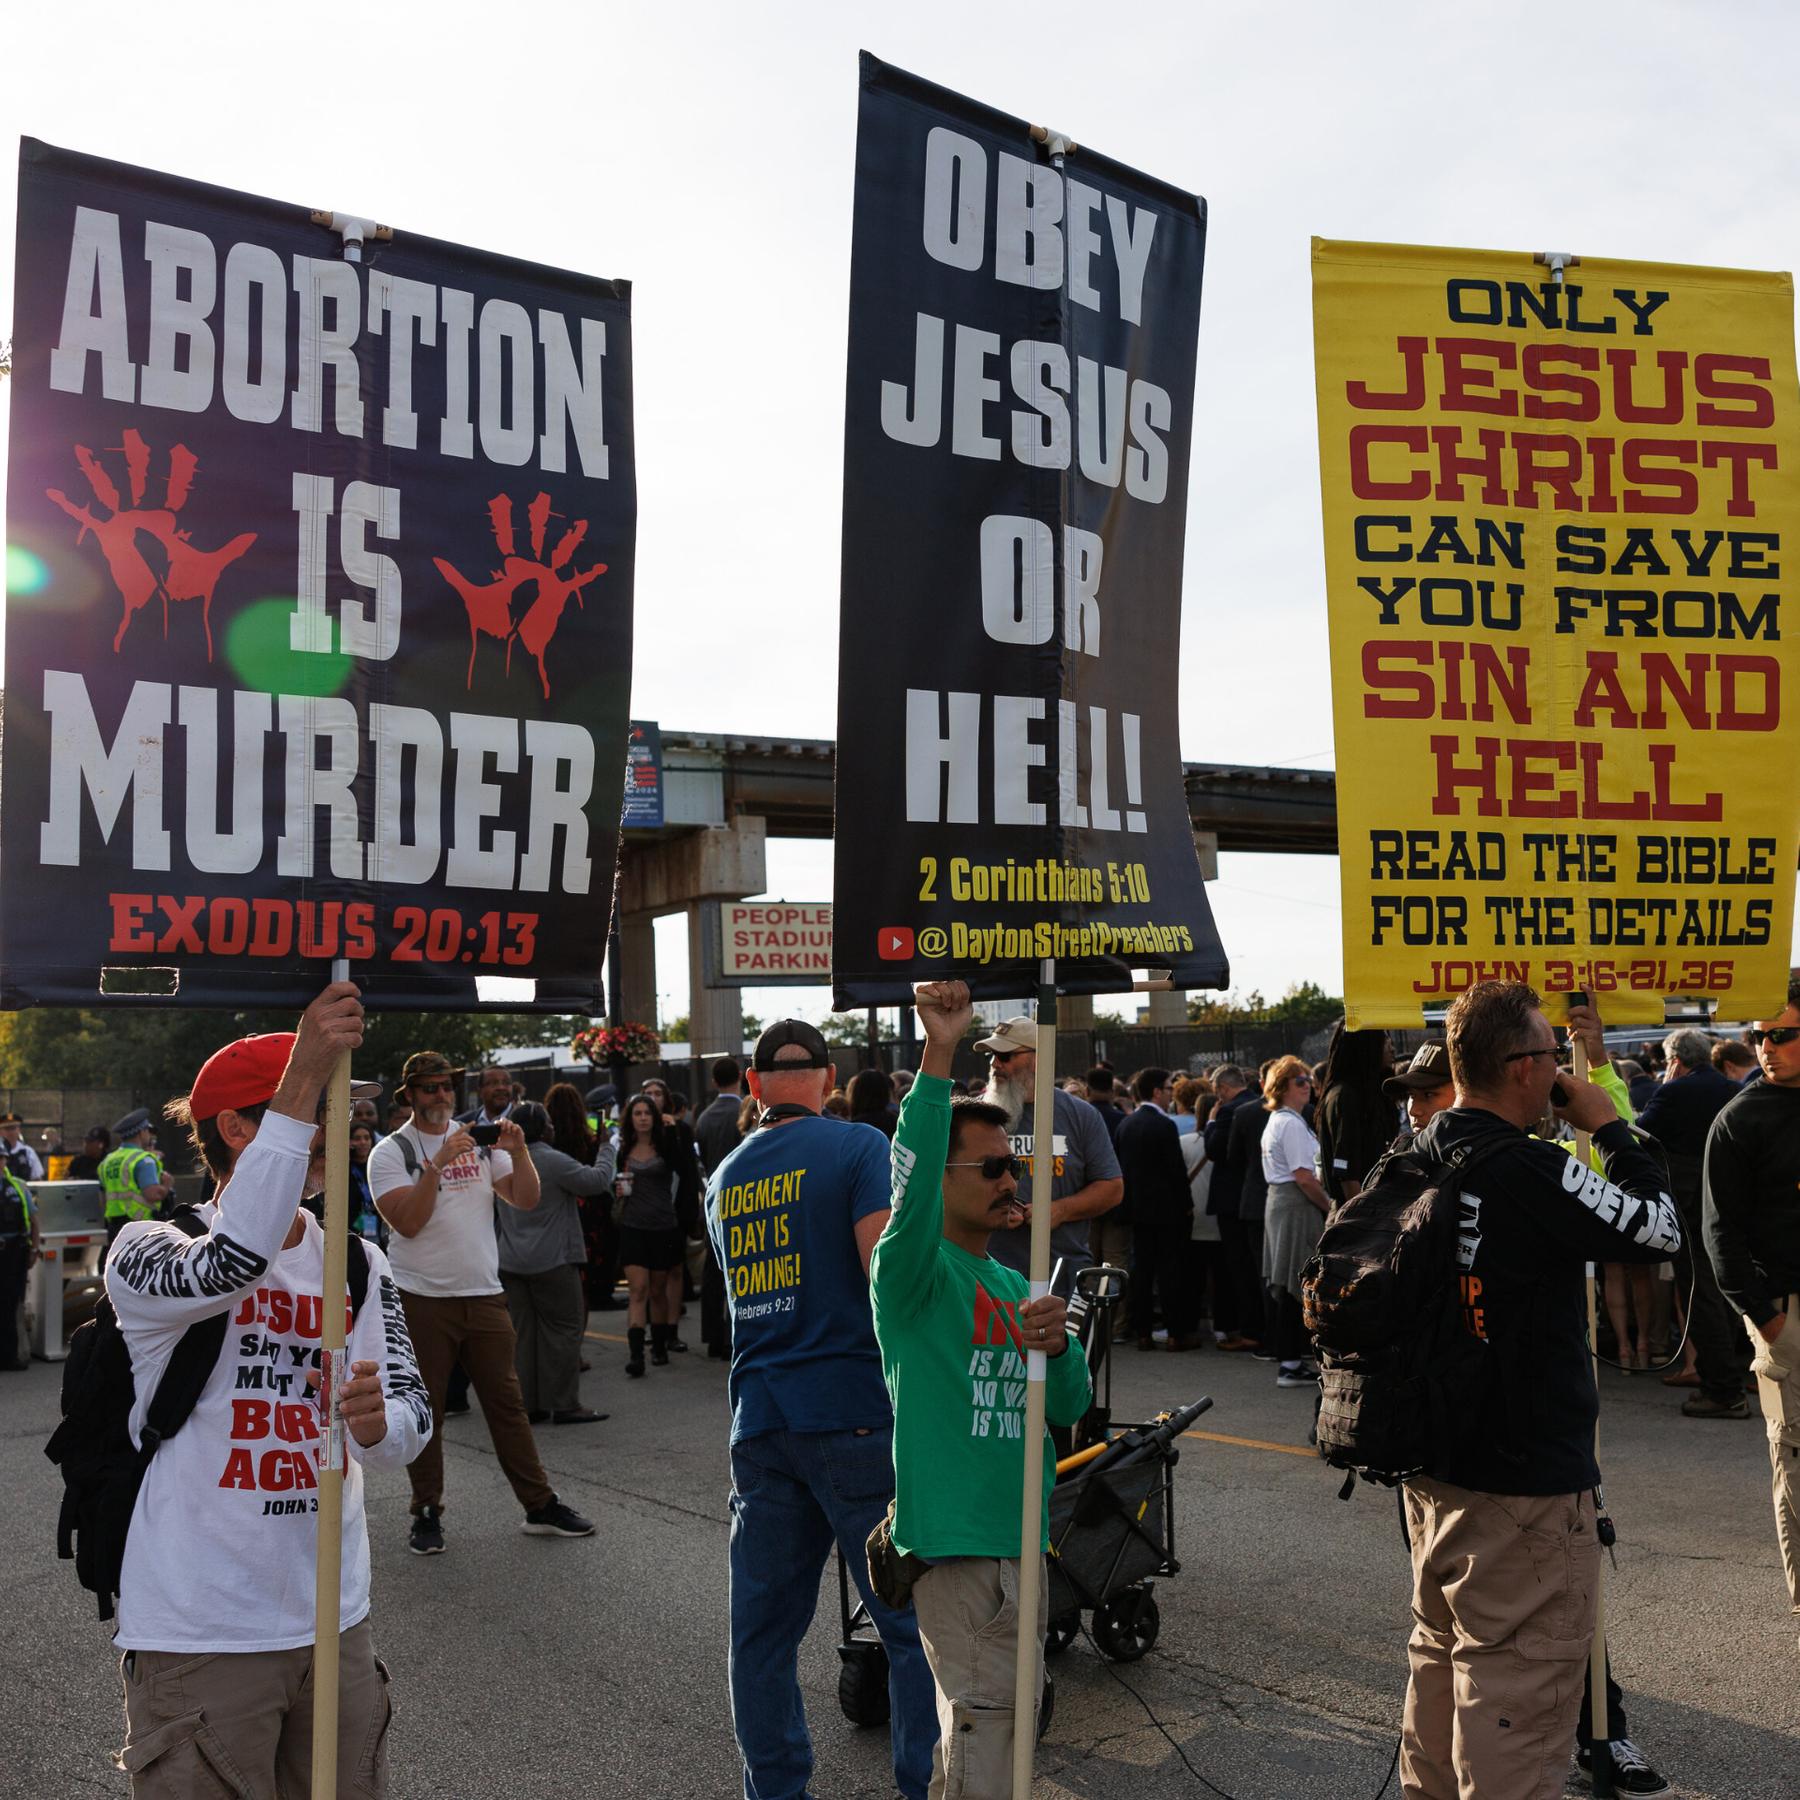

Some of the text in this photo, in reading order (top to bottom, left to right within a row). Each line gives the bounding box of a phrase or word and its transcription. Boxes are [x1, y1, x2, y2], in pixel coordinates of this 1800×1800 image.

[923, 127, 1157, 327] OBEY
[1447, 278, 1669, 335] ONLY
[50, 205, 609, 480] ABORTION
[881, 312, 1172, 503] JESUS
[1346, 336, 1775, 428] JESUS
[1350, 424, 1778, 517] CHRIST
[290, 472, 401, 661] IS
[1354, 515, 1780, 579] CAN SAVE
[980, 515, 1103, 657] OR
[1357, 577, 1780, 641] YOU FROM
[1361, 640, 1780, 732] SIN AND
[40, 669, 595, 894] MURDER
[906, 688, 1147, 833] HELL!
[1430, 735, 1723, 822] HELL
[919, 857, 1150, 903] 2 Corinthians 5:10
[1370, 829, 1776, 885] READ THE BIBLE
[109, 893, 539, 966] EXODUS 20:13
[917, 921, 1193, 964] @DaytonStreetPreachers
[1371, 896, 1772, 946] FOR THE DETAILS
[735, 953, 829, 969] PARKIN
[1413, 960, 1734, 992] JOHN 3:16-21,36
[443, 1165, 480, 1180] ORRY
[1562, 1155, 1641, 1233] OBEY
[730, 1213, 789, 1258] DAY IS
[737, 1302, 772, 1321] Hebrews
[235, 1365, 293, 1397] MUT
[968, 1350, 993, 1377] IS
[230, 1398, 320, 1443] BOR
[971, 1409, 991, 1437] IS
[218, 1447, 320, 1491] AGA
[262, 1498, 319, 1516] JOHN 3
